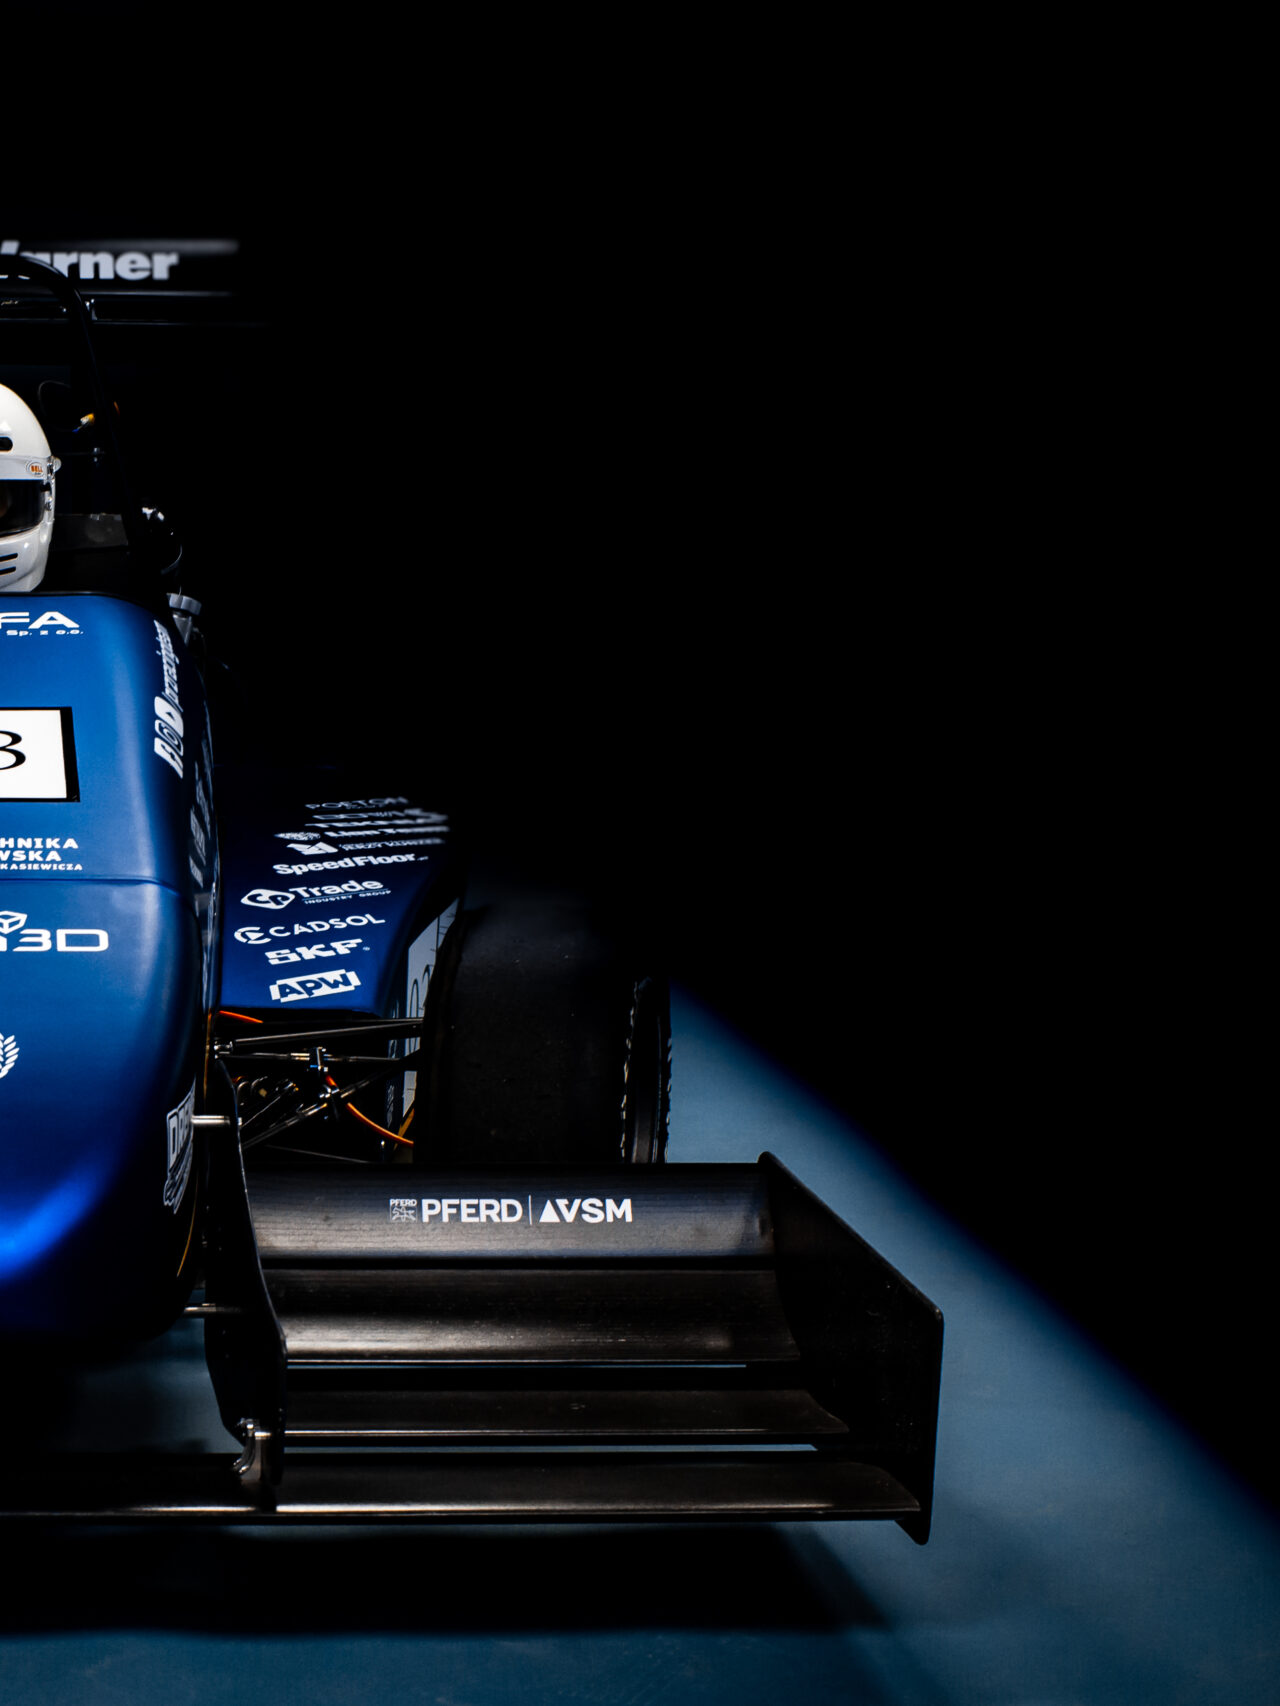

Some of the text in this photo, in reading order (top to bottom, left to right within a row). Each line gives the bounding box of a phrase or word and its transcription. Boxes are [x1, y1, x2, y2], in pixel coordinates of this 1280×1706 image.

[6, 629, 32, 637] Sp.
[289, 880, 384, 898] Trade
[268, 913, 387, 938] CADSOL
[275, 972, 356, 1000] APW
[422, 1199, 523, 1223] PFERD
